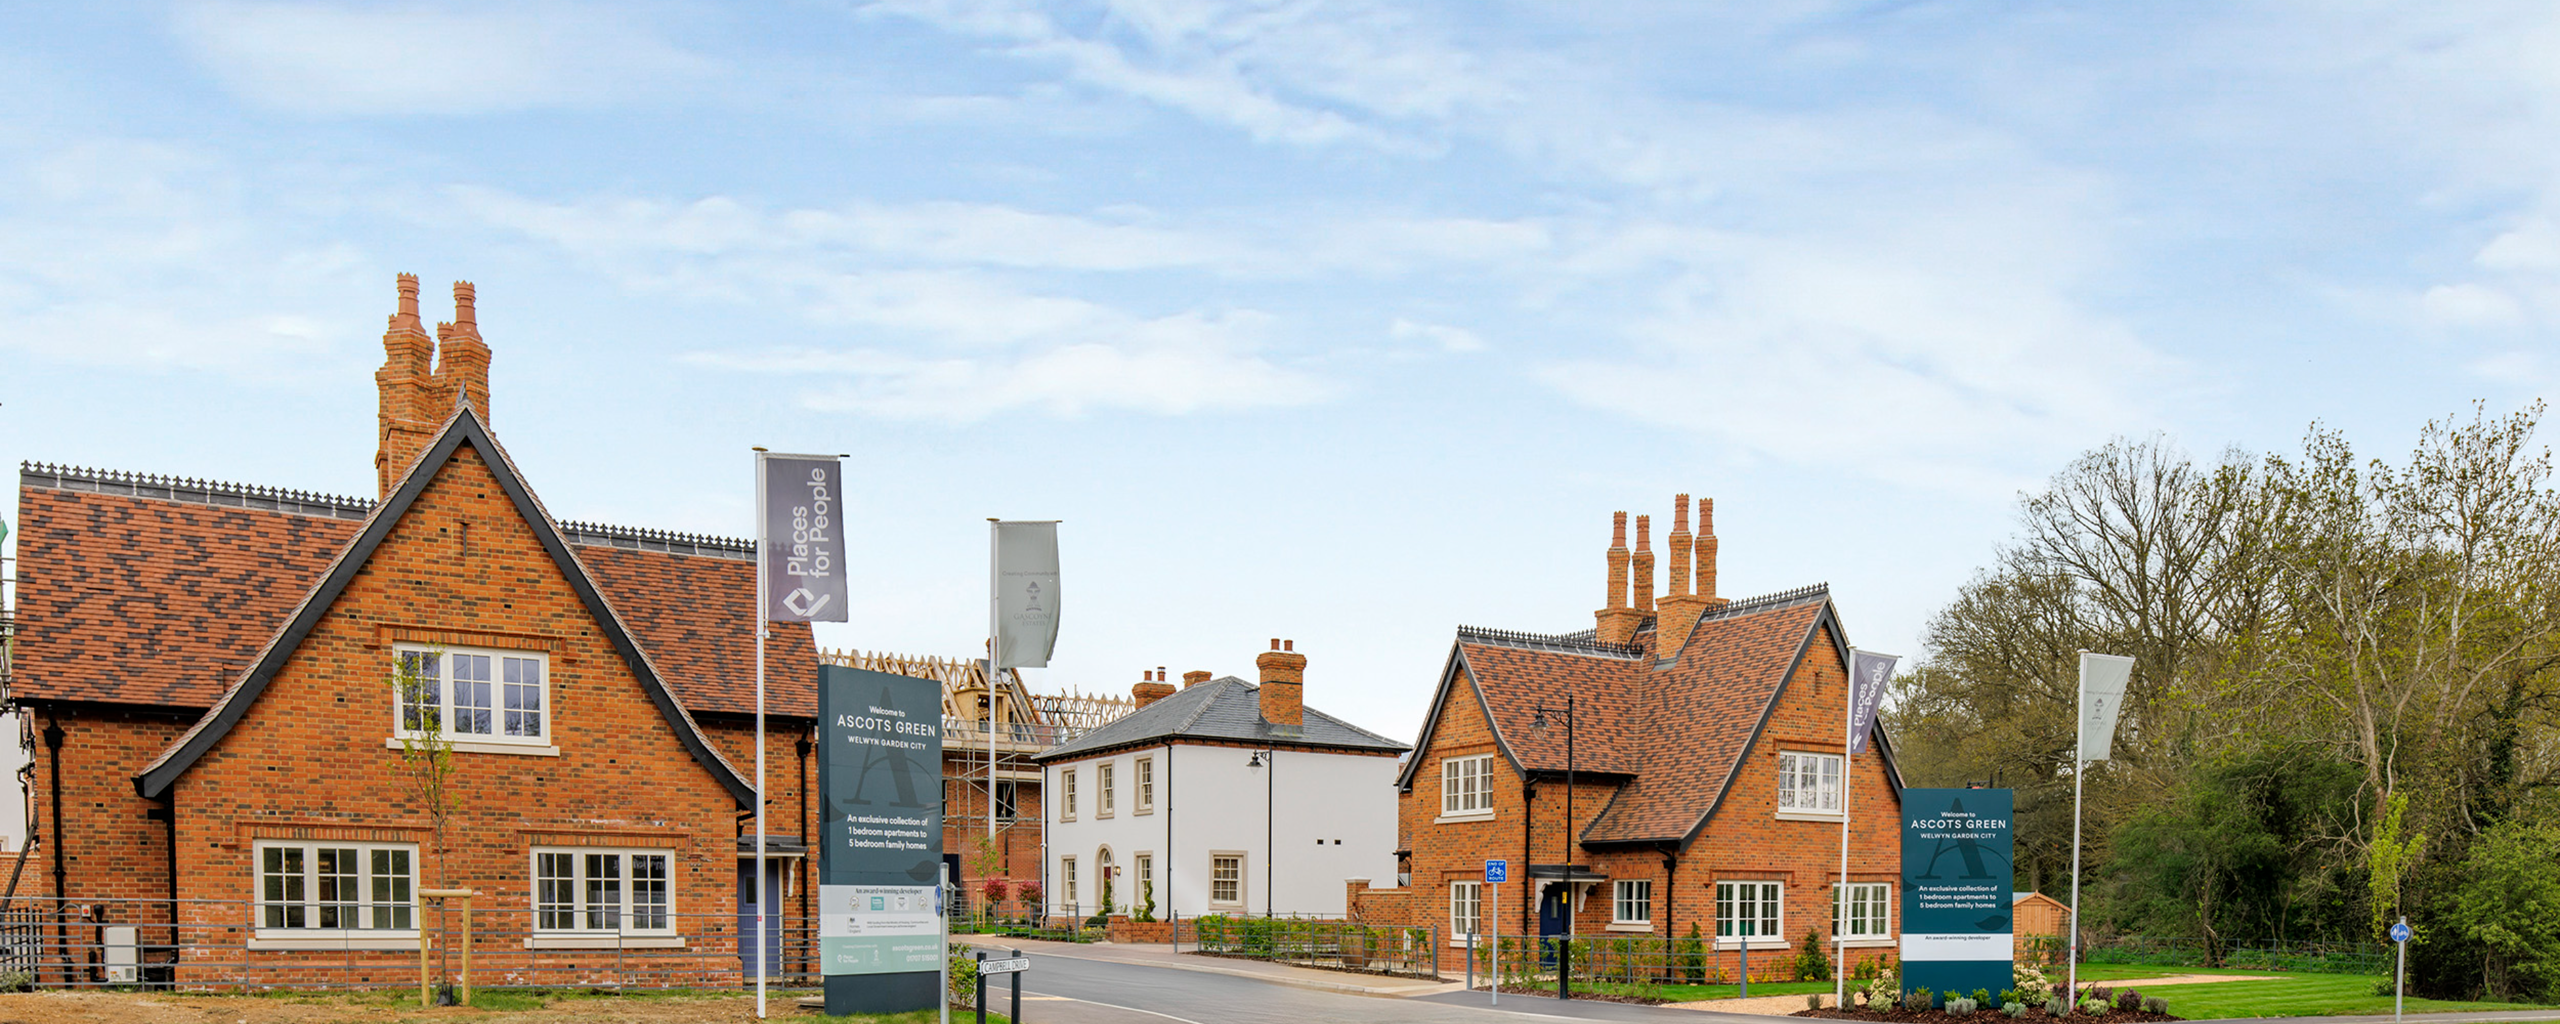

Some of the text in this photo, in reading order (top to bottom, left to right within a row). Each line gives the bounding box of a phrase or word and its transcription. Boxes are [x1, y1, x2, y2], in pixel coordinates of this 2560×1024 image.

[806, 467, 831, 579] for People
[787, 506, 808, 576] Places
[1013, 612, 1051, 621] GASCOYN
[1854, 683, 1868, 727] Places
[869, 705, 906, 718] Welcome to
[837, 713, 936, 737] ASCOTS GREEN
[847, 735, 927, 750] WELWYN GARDEN CITY
[847, 814, 928, 826] An exclusive collection of
[1910, 819, 2006, 829] ASCOTS GREEN
[848, 826, 927, 838] 1 bedroom apartments to
[849, 839, 927, 851] 5 bedroom family homes
[863, 888, 899, 896] award-winning
[1953, 894, 1989, 902] apartments
[1954, 902, 1974, 910] family
[892, 943, 938, 953] ascotsgreen.co.uk
[984, 959, 1027, 972] CAMPBELL DRIVE
